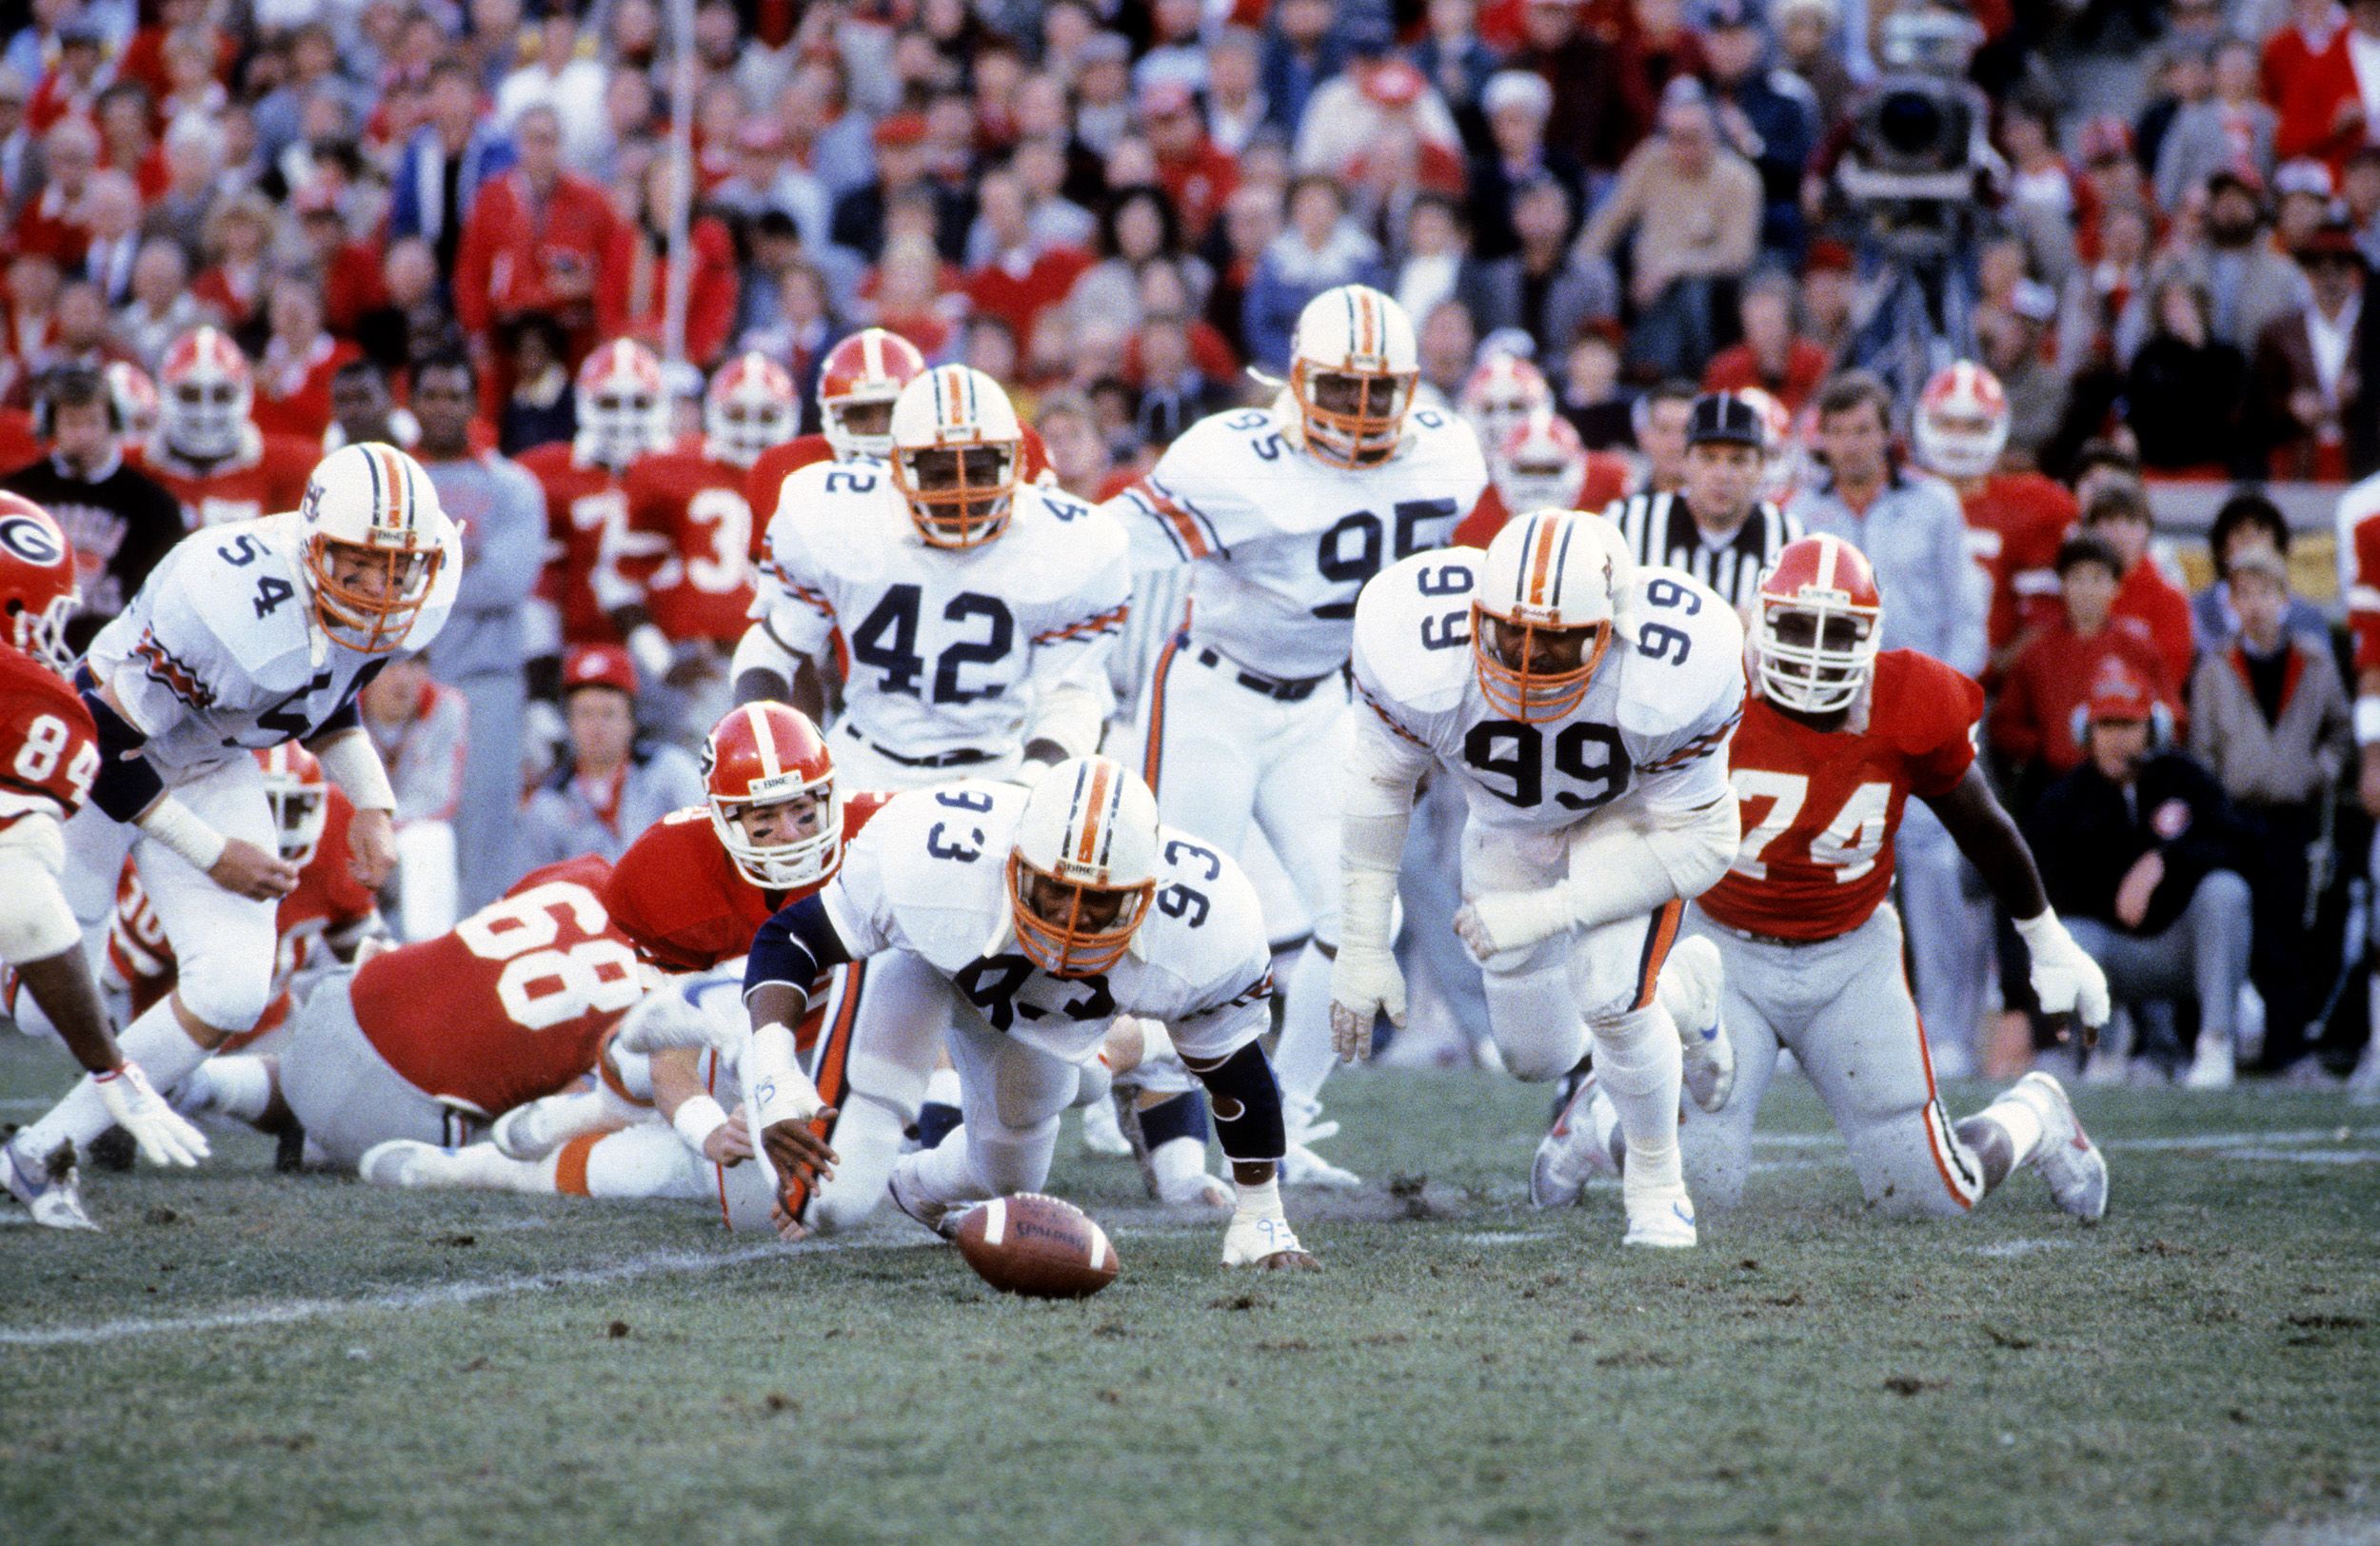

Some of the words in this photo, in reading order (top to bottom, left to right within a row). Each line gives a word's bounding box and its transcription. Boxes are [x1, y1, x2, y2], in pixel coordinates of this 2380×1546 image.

[217, 533, 294, 620] 54
[1418, 565, 1475, 651] 99
[852, 584, 1015, 704] 42
[1637, 579, 1702, 666] 99
[13, 713, 102, 805] 84
[1465, 721, 1632, 809] 99
[1729, 768, 1893, 884] 74
[1157, 841, 1220, 929] 93
[455, 881, 641, 1031] 68
